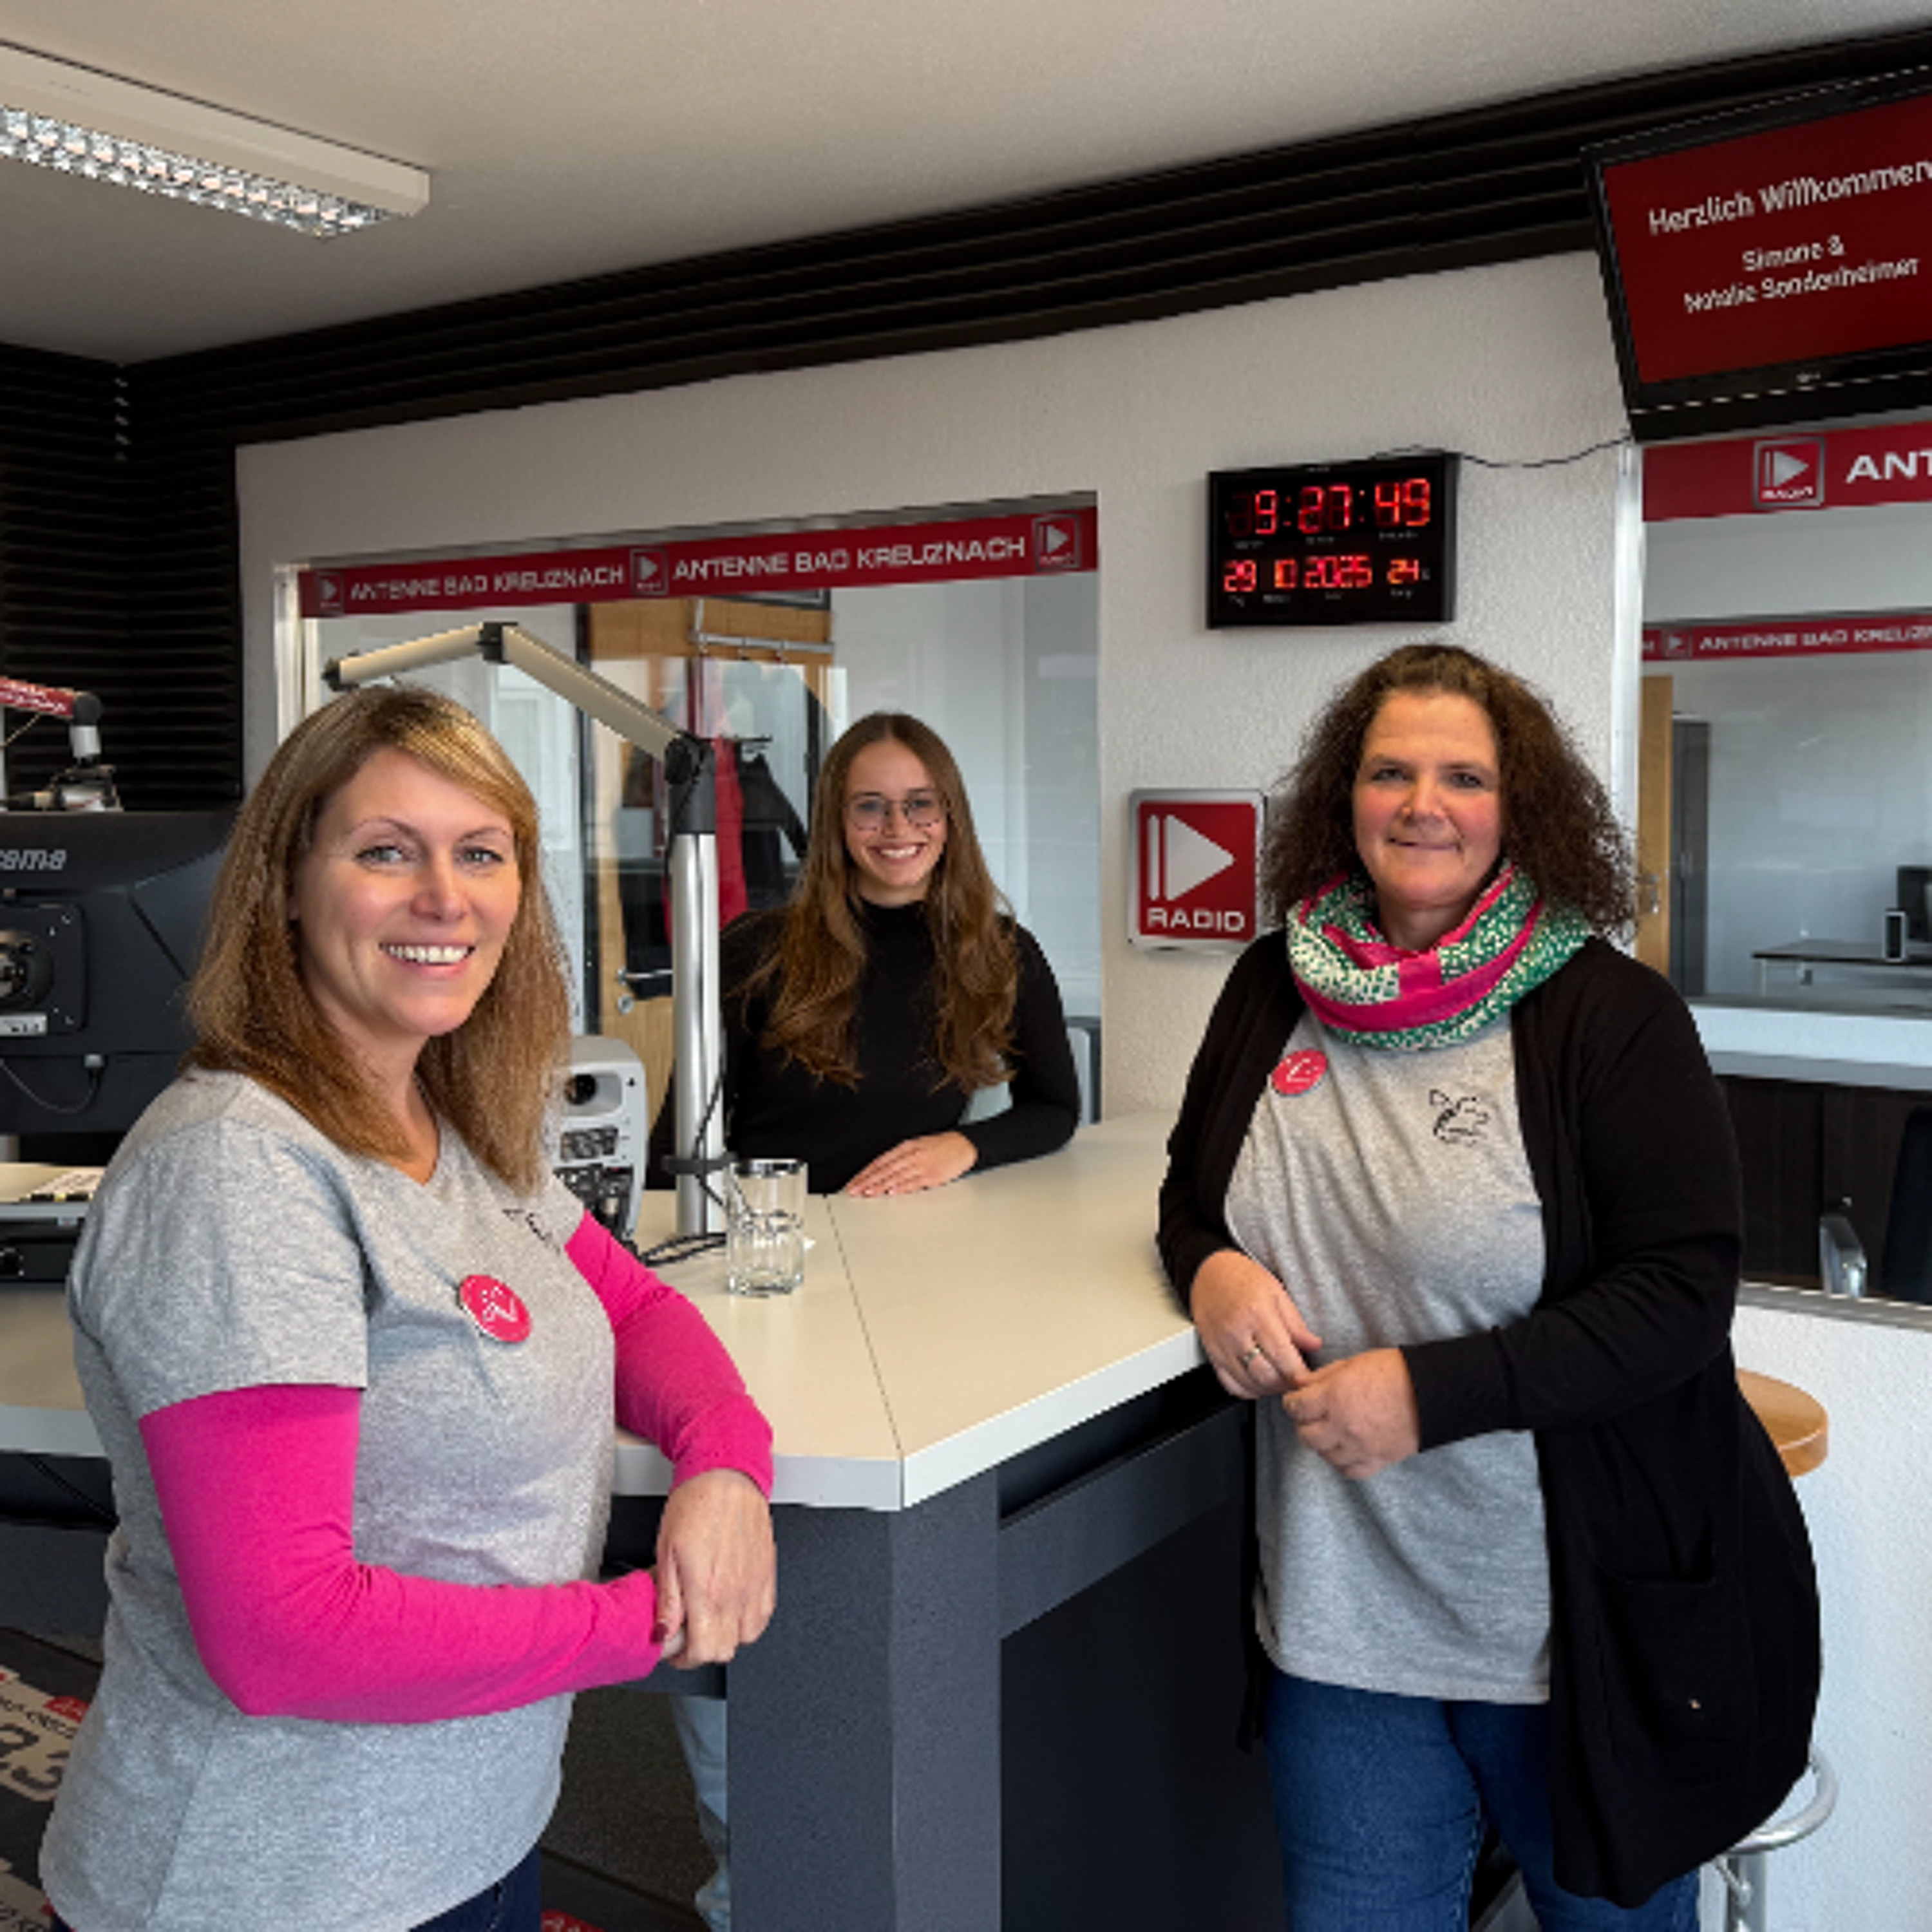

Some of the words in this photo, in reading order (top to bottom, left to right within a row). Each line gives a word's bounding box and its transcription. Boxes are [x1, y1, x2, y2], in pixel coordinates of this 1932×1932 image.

[1649, 191, 1754, 235] Herzlich
[1743, 242, 1823, 271] Simone
[1828, 234, 1845, 256] &
[1684, 283, 1757, 313] Natalie
[1255, 478, 1430, 534] 9:27:49
[672, 552, 790, 580] ANTENNE
[795, 549, 848, 573] BAD
[857, 536, 1025, 569] KREUZNACH
[1305, 556, 1372, 589] 2025
[350, 578, 441, 600] ANTENNE
[444, 575, 488, 596] BAD
[494, 565, 624, 592] KREUZNACH
[1699, 633, 1797, 650] ANTENNE
[1803, 629, 1848, 646] BAD
[0, 849, 68, 871] ama
[1146, 907, 1245, 932] RADIO
